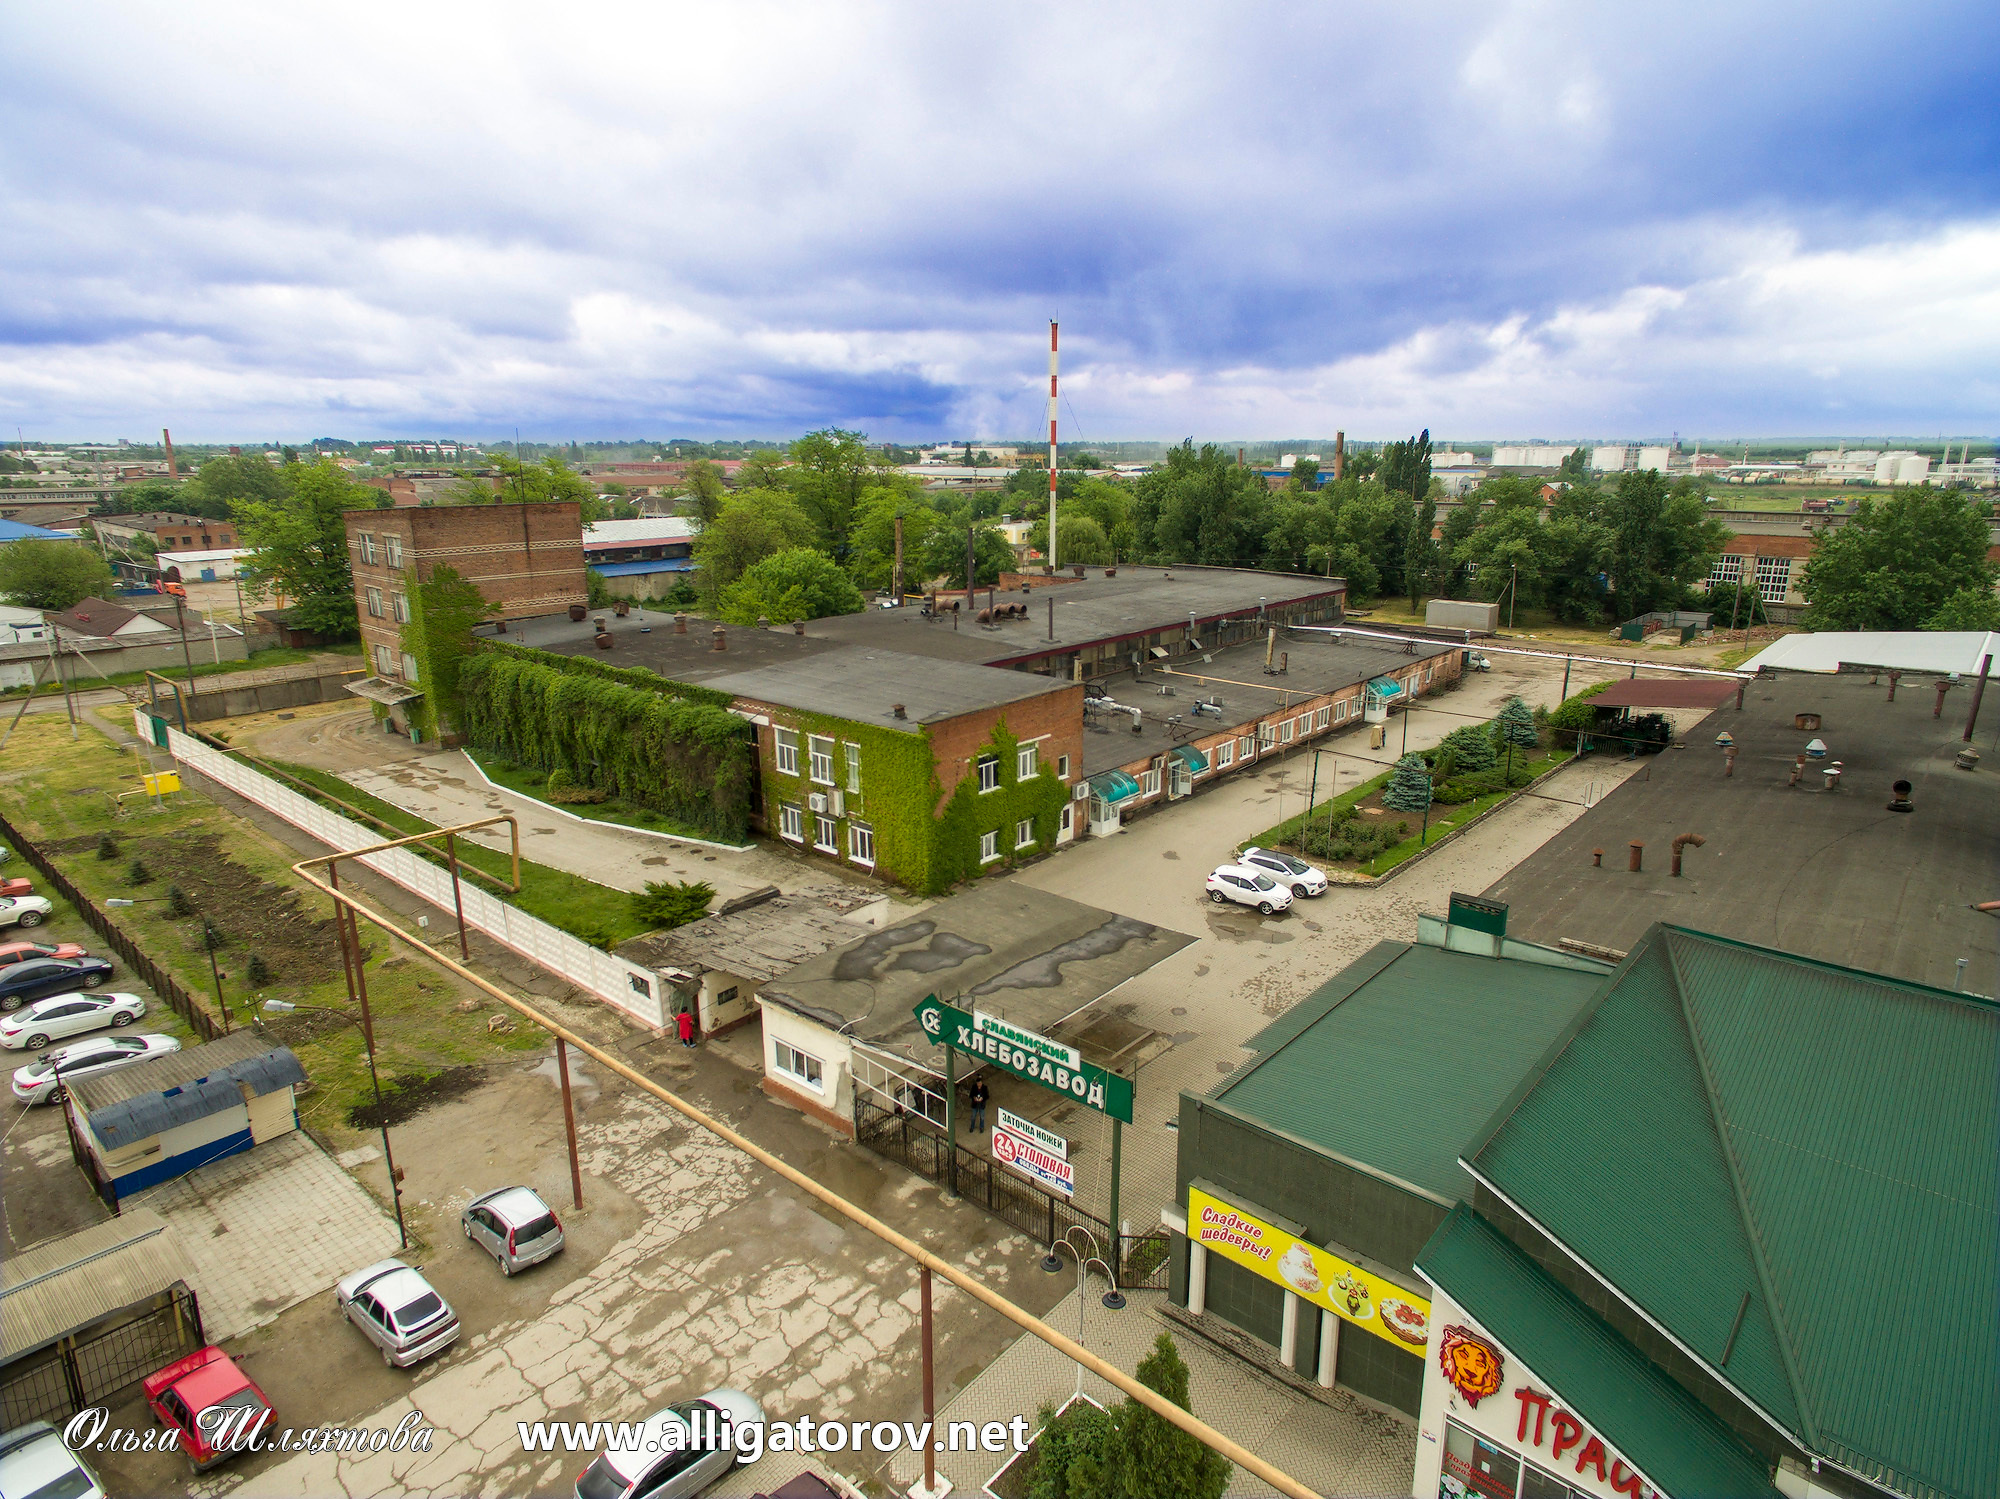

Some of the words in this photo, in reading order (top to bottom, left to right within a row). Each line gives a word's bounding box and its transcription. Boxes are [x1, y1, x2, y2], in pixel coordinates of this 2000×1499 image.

[981, 1018, 1070, 1063] СЛАВЯНСКИЙ
[957, 1025, 1105, 1109] ХЛЕБОЗАВОД
[997, 1134, 1013, 1153] 24
[1002, 1112, 1035, 1136] ЗАТОЧКА
[1036, 1130, 1063, 1149] НОЖЕЙ
[1017, 1143, 1071, 1179] СТОЛОВАЯ
[1201, 1206, 1263, 1239] Сладкие
[1201, 1227, 1273, 1260] шедевры!
